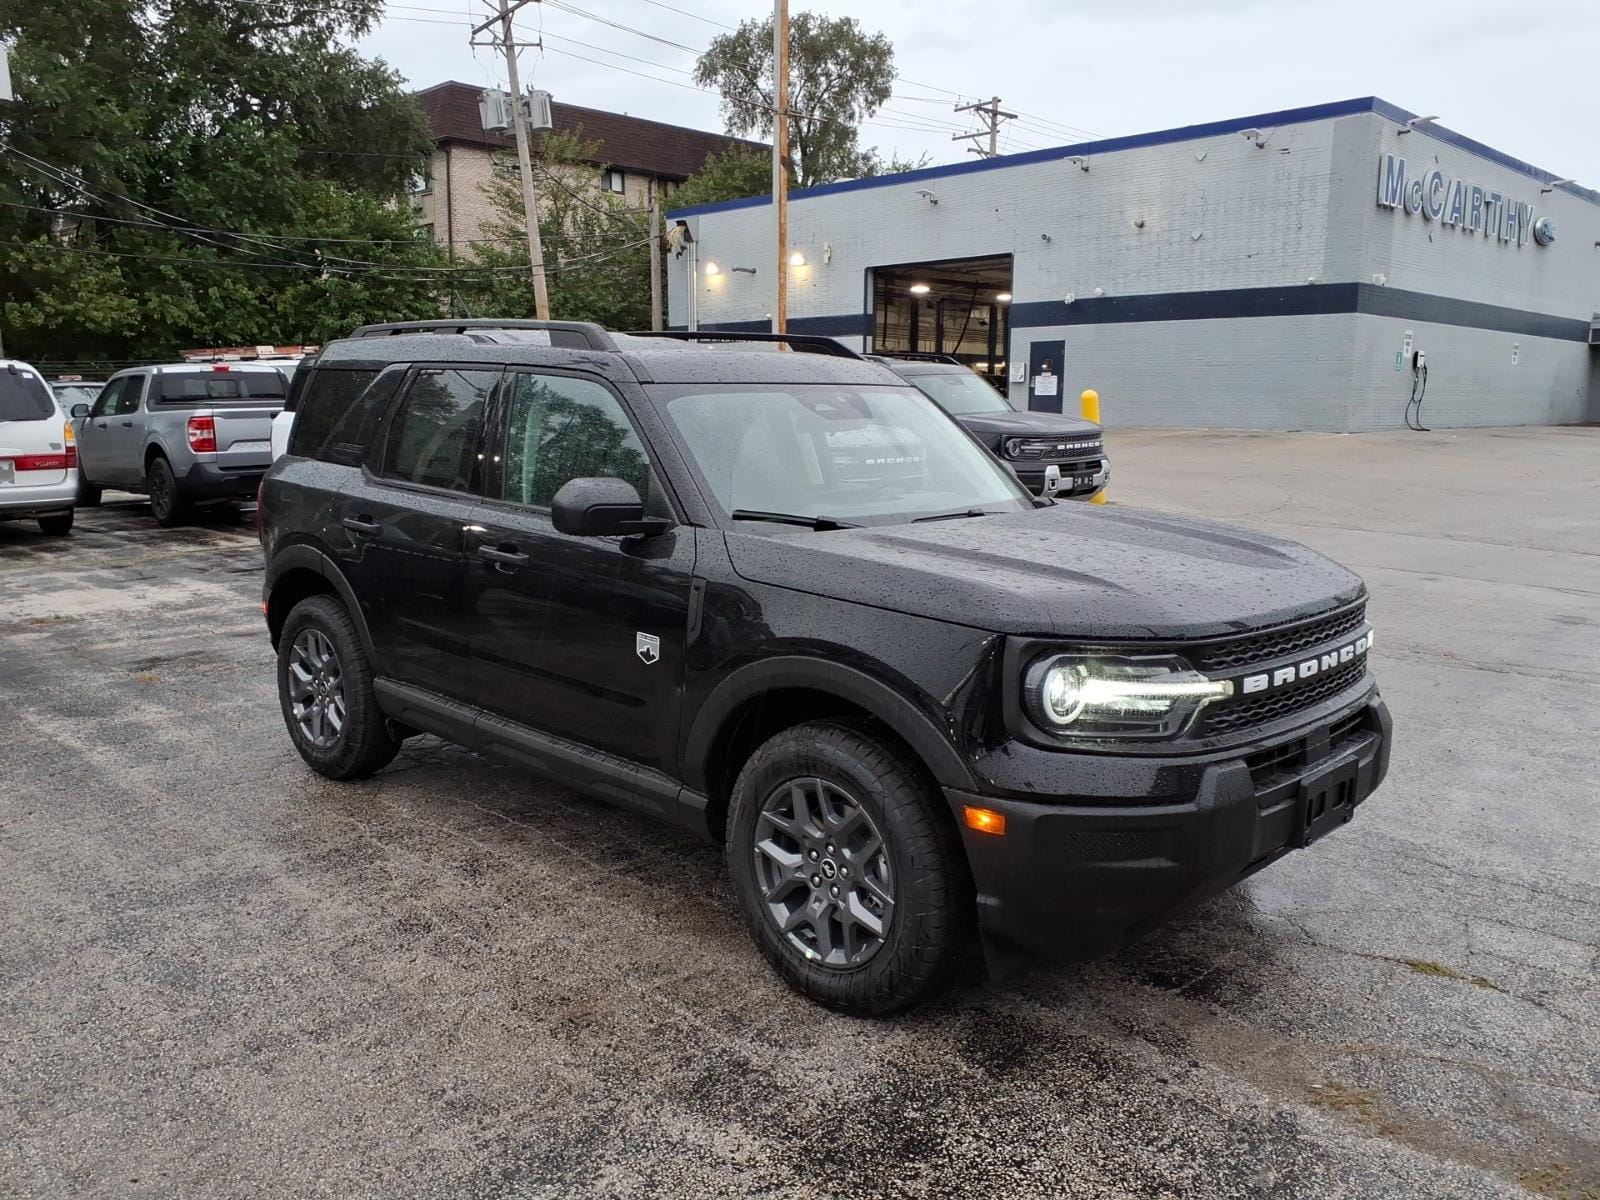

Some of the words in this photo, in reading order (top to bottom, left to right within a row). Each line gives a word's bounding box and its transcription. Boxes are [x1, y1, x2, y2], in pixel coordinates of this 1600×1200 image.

[1378, 154, 1536, 246] McCARTHY
[1057, 441, 1100, 450] BRONCO
[1243, 637, 1366, 694] BRONCO
